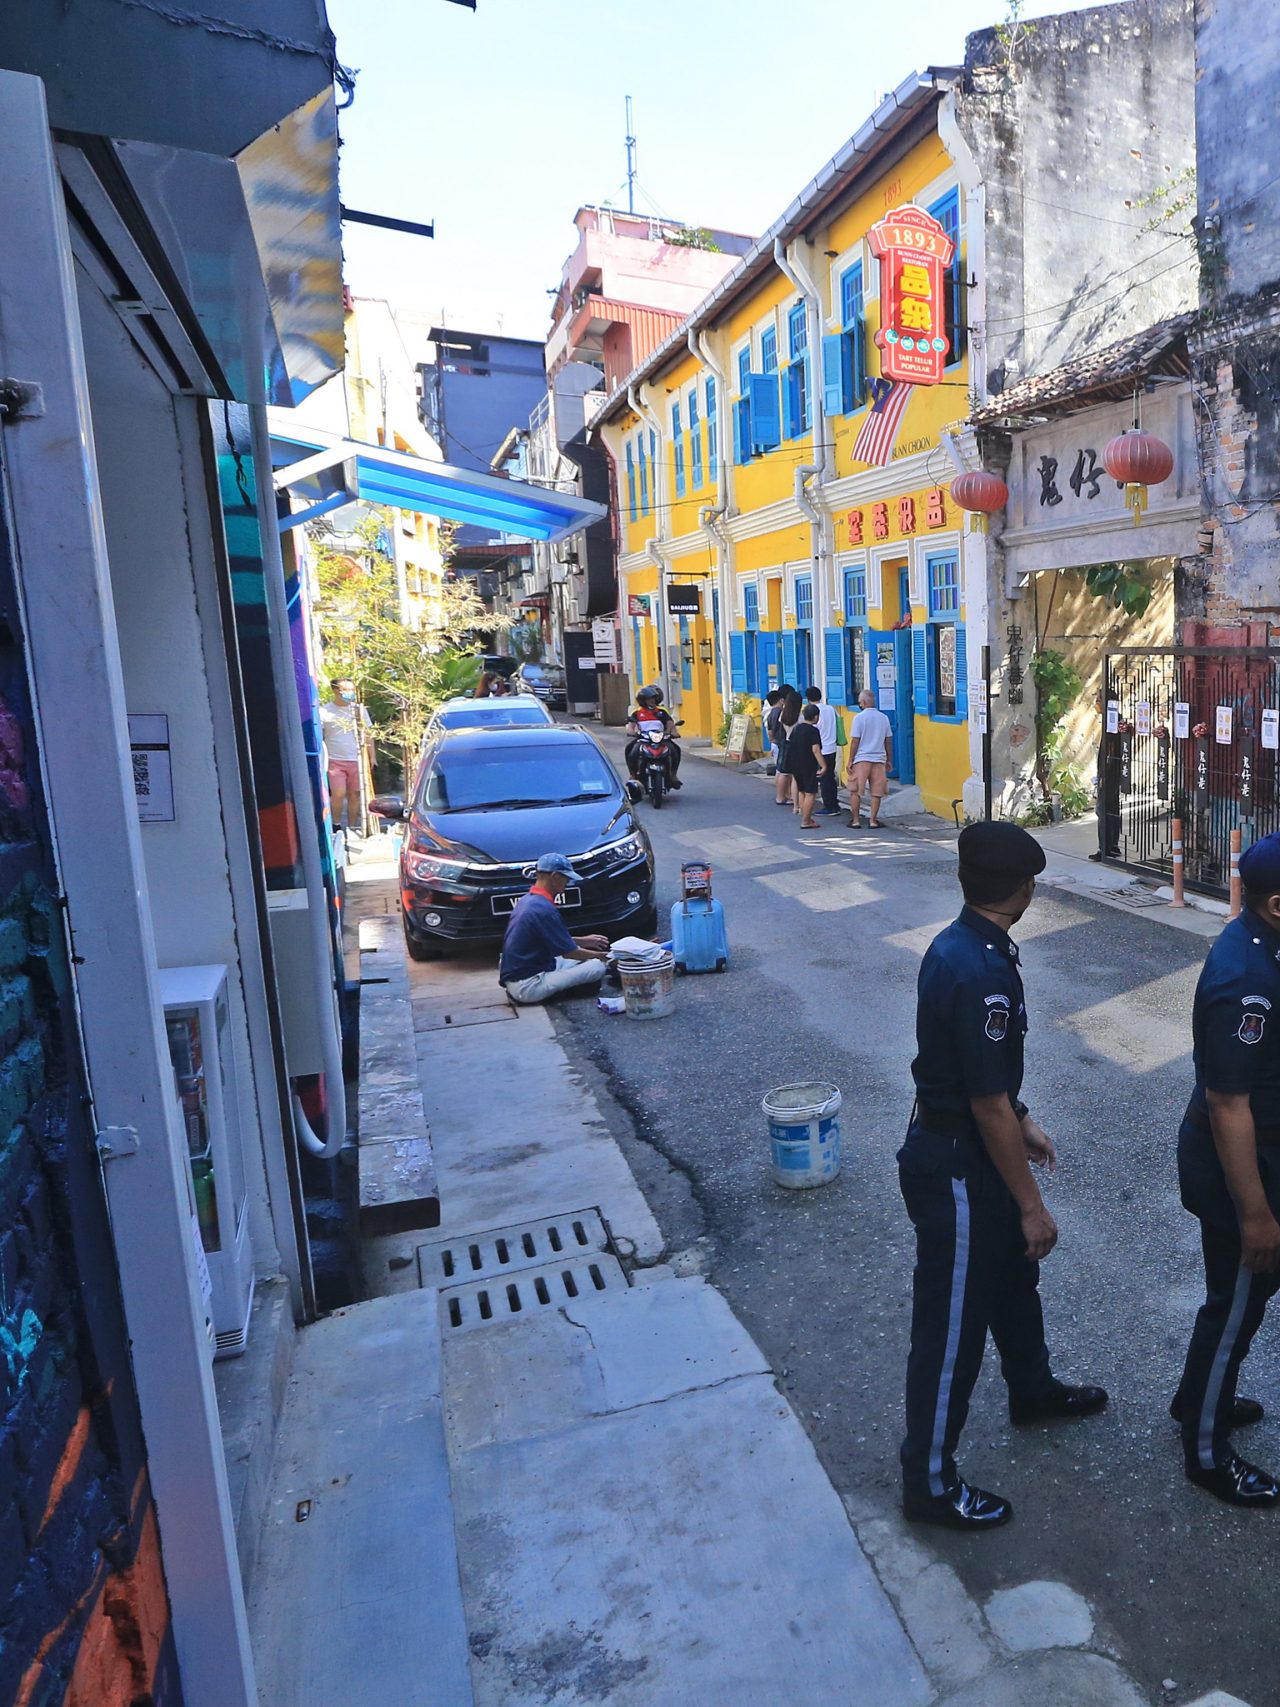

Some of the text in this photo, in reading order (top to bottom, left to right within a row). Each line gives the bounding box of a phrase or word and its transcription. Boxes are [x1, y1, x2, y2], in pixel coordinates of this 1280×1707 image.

[903, 215, 927, 226] SINCE
[893, 229, 936, 251] 1893
[898, 354, 912, 362] TART
[901, 363, 930, 373] POPULAR
[1241, 756, 1252, 797] 鬼仔巷
